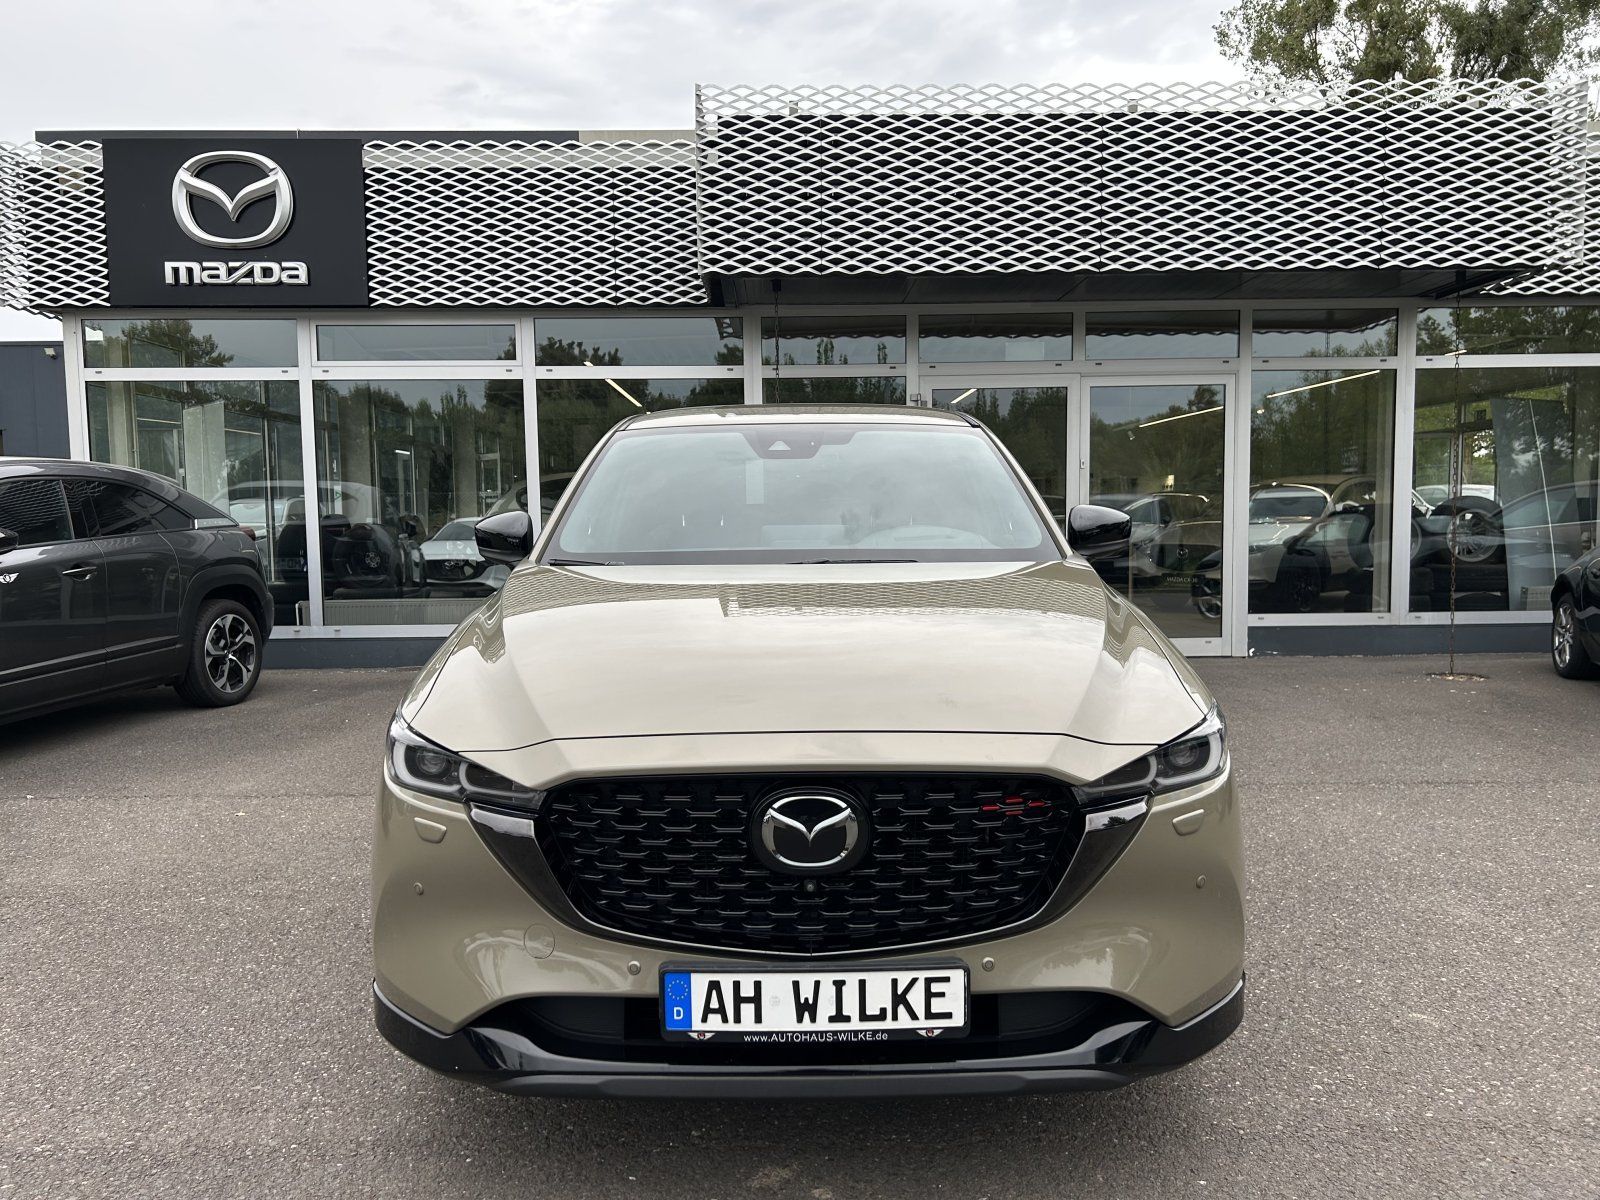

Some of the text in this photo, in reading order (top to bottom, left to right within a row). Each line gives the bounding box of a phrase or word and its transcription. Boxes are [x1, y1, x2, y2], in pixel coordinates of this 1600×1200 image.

[700, 976, 953, 1024] AH WILKE
[673, 1006, 684, 1020] D
[743, 1031, 889, 1043] www.AUTOHAUS-WILKE.de
